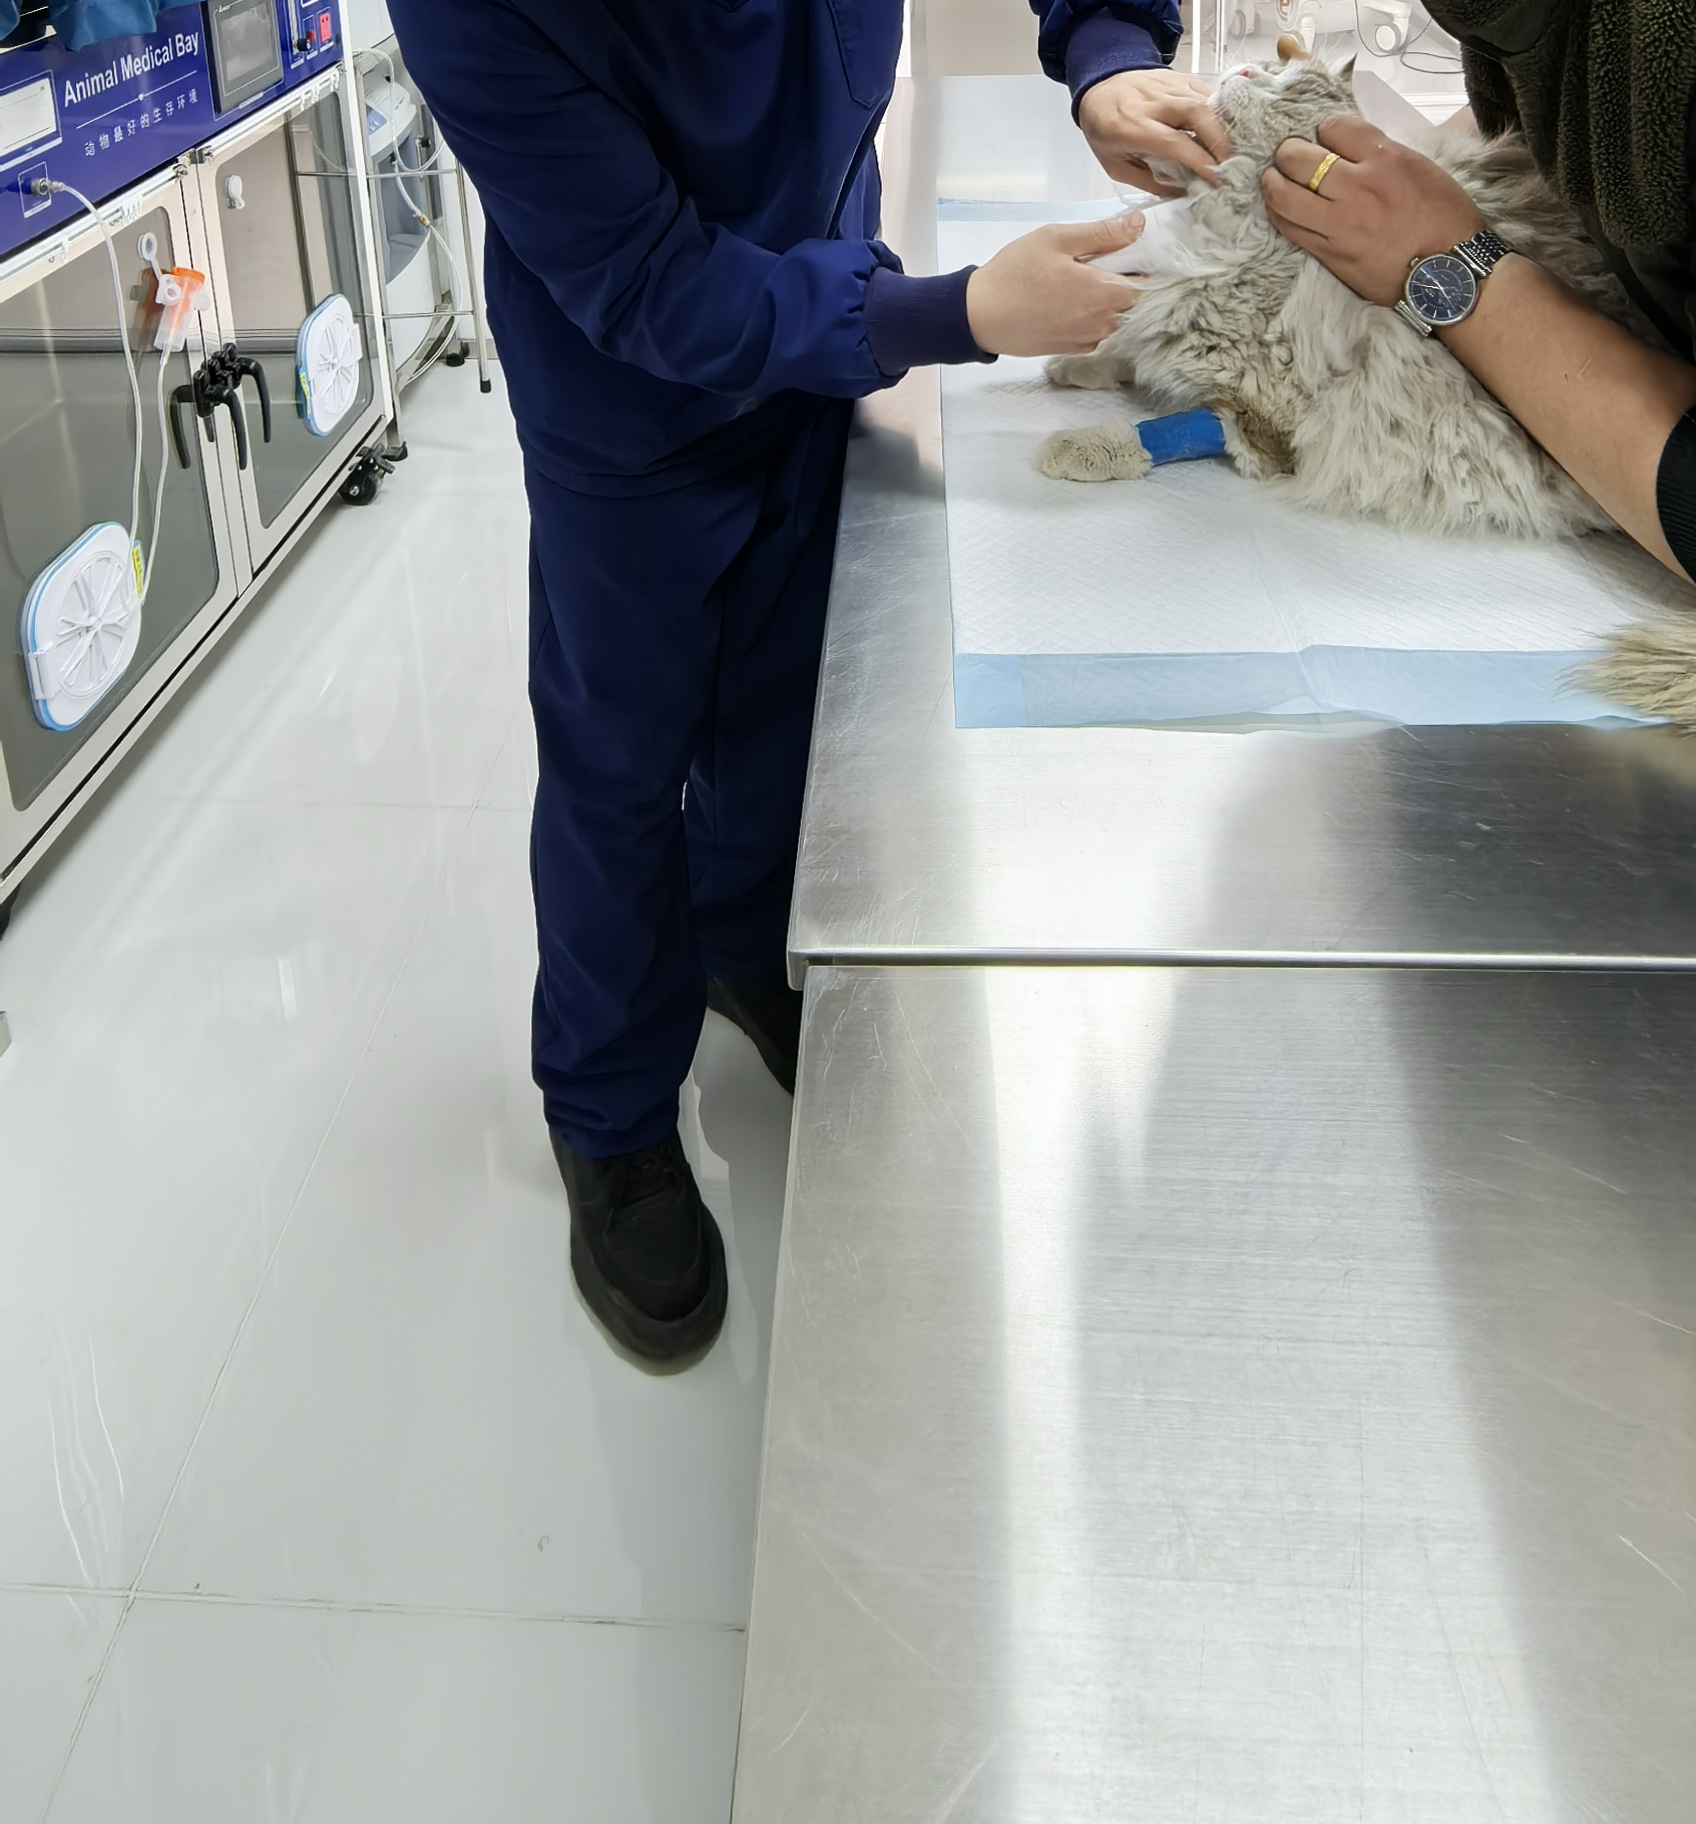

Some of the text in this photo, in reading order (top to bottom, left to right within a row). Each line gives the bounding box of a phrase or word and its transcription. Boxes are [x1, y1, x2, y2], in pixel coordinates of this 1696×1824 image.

[64, 31, 199, 108] Animal Medical Bay
[84, 88, 198, 156] 动物最好的生存环境
